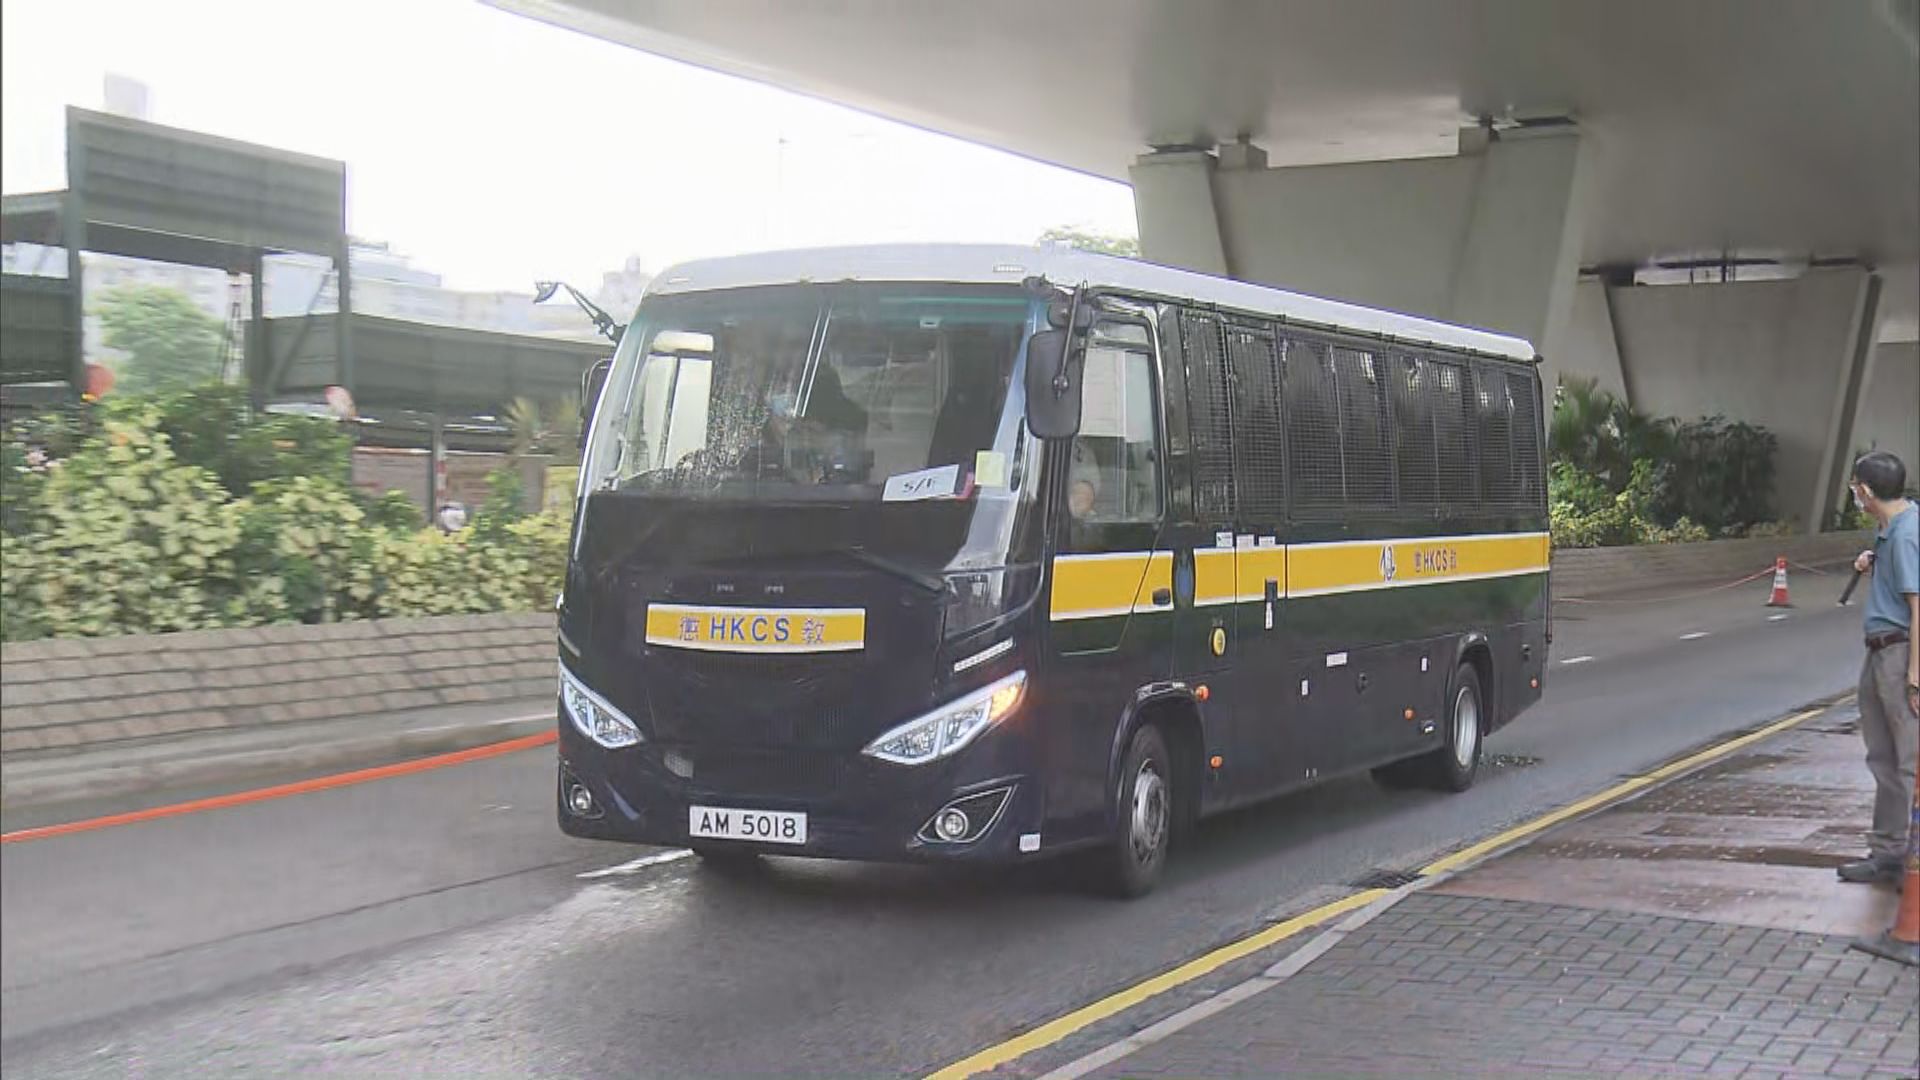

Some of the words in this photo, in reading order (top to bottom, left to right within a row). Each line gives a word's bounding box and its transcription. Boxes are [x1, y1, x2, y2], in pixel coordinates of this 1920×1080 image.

[710, 616, 790, 641] HKCS
[700, 812, 729, 833] AM
[741, 814, 796, 838] 5018
